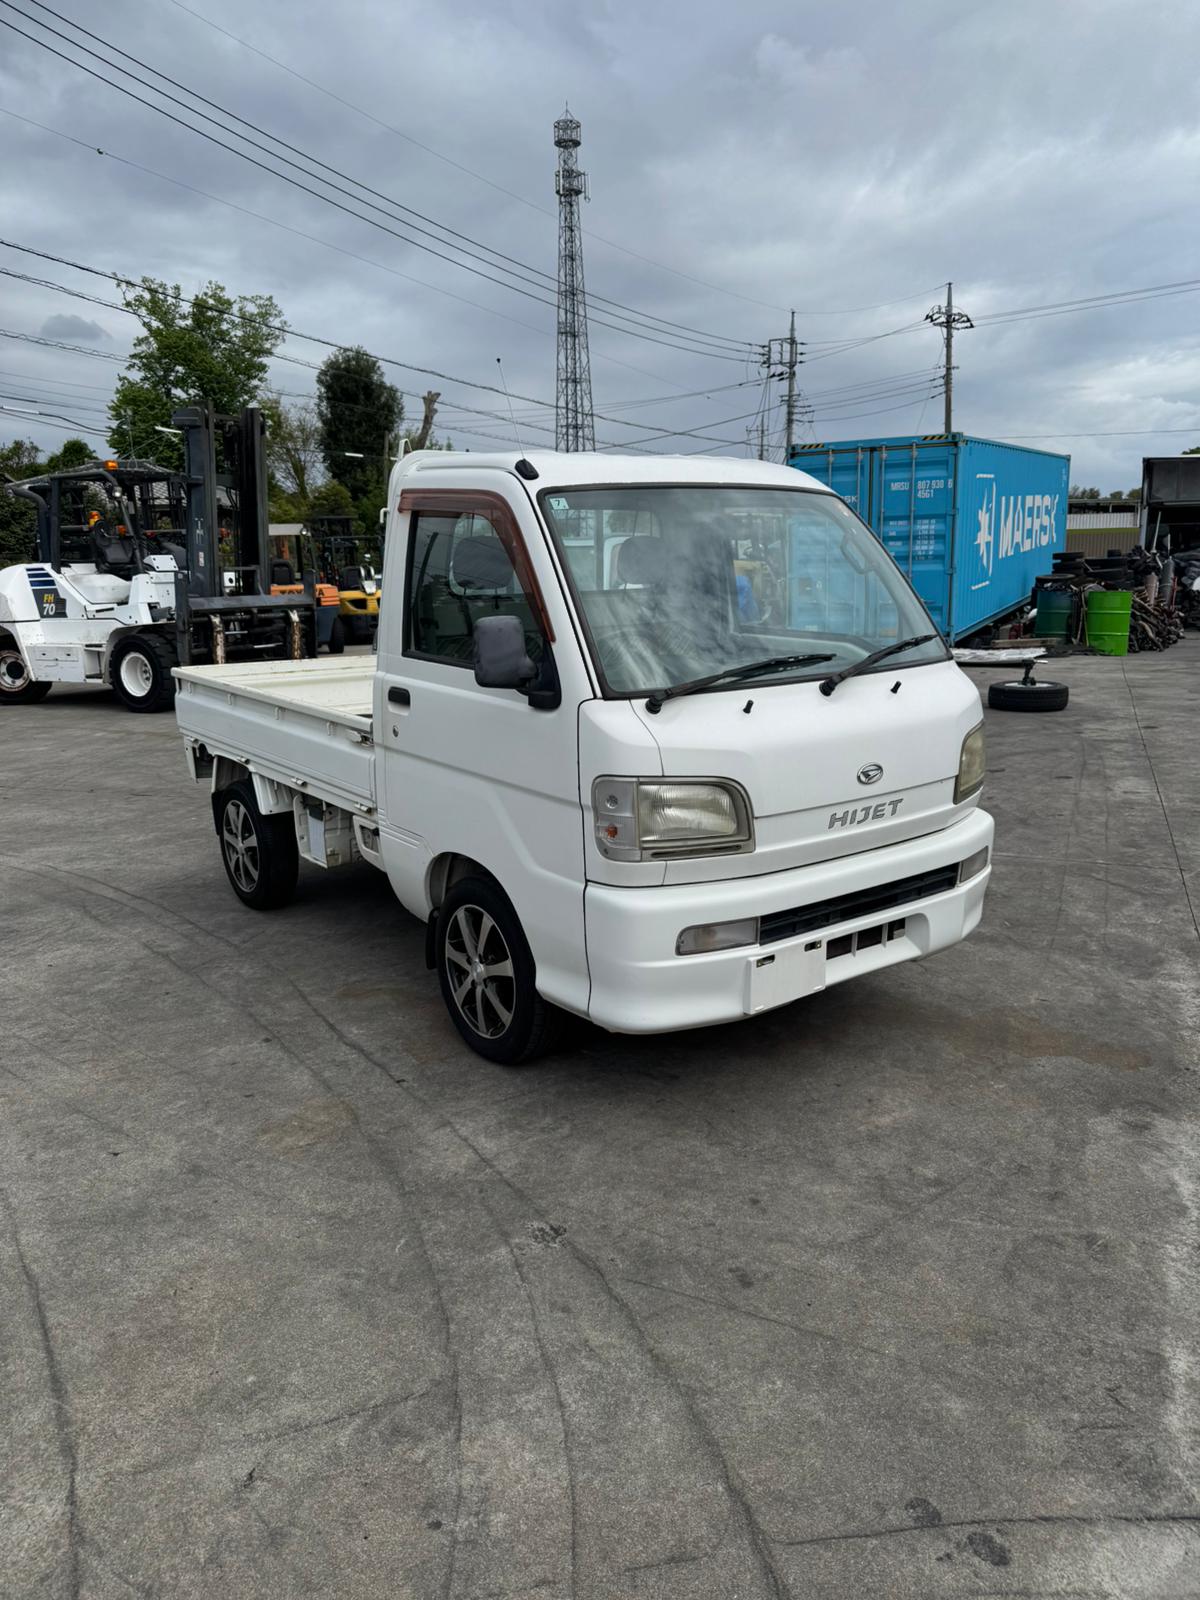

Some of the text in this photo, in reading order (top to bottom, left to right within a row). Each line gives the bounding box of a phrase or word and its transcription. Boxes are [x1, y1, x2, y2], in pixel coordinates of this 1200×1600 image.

[890, 482, 910, 491] MRSU
[999, 494, 1059, 559] MAERSK
[43, 593, 55, 604] FH
[43, 603, 56, 616] 70
[828, 798, 904, 829] HIJET
